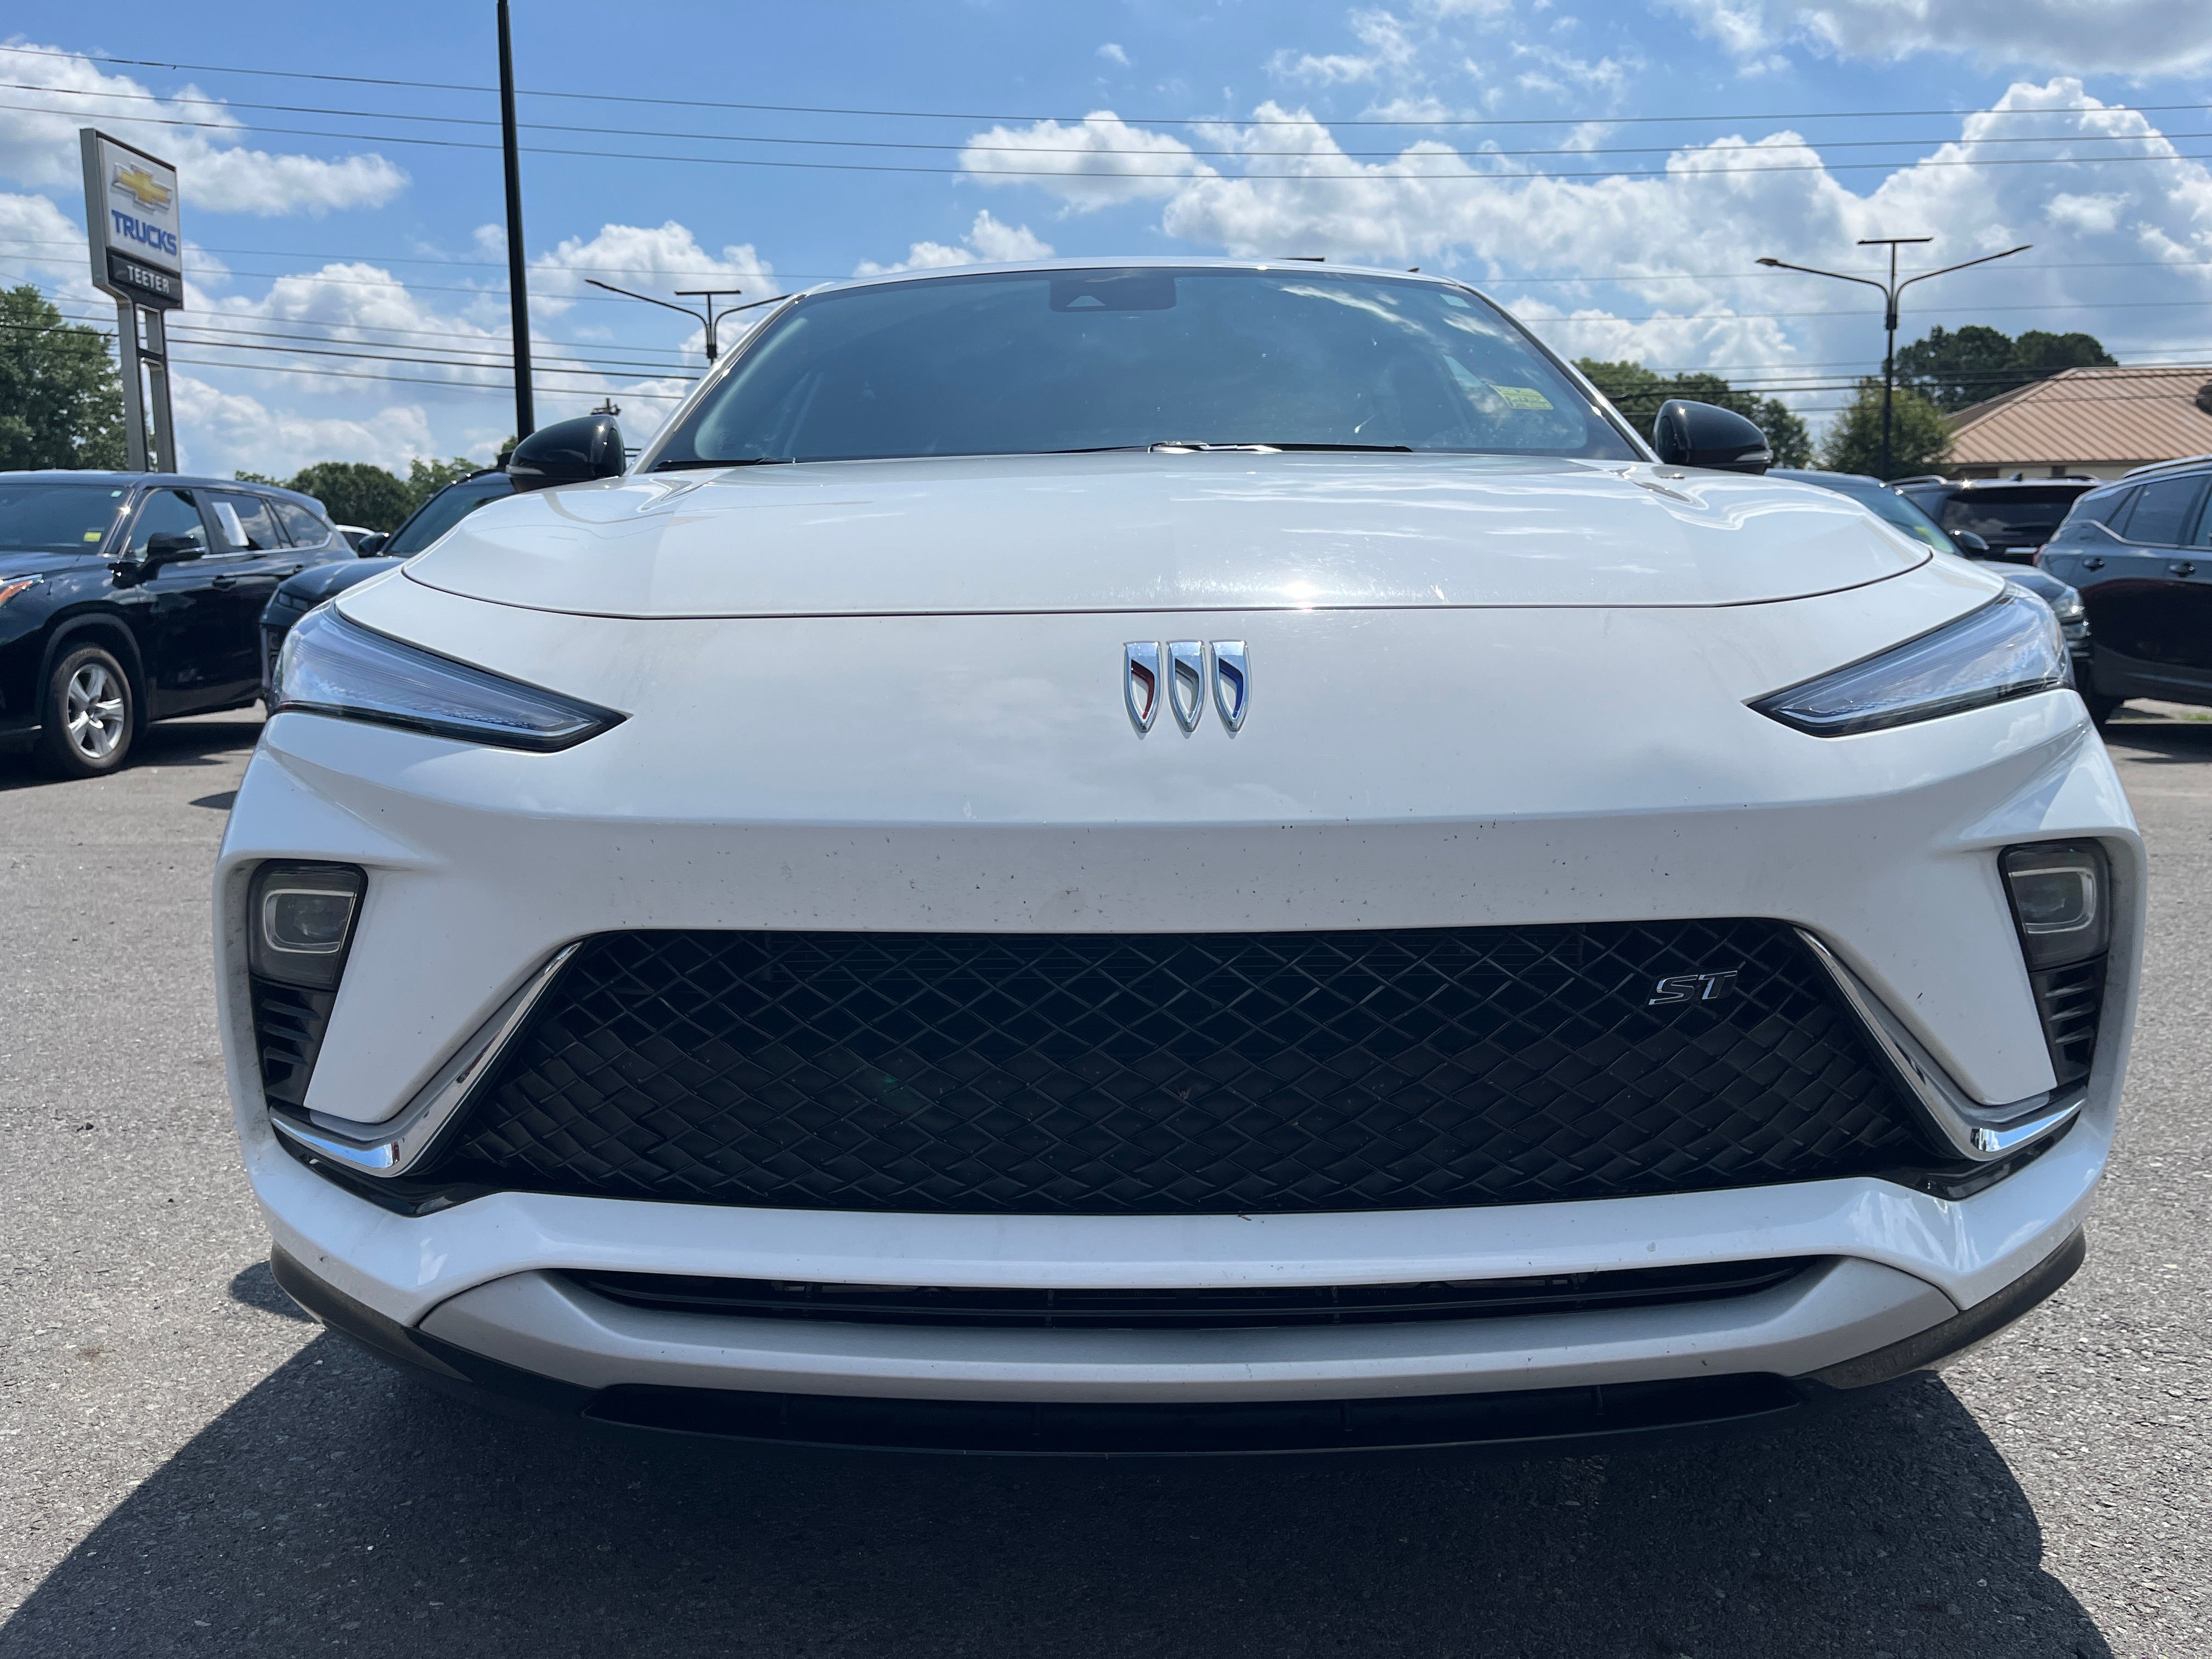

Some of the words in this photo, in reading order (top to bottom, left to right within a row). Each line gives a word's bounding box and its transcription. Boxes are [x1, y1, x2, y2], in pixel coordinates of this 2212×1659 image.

[111, 209, 177, 256] TRUCKS
[127, 264, 170, 294] TEETER
[1648, 970, 1737, 1005] ST
